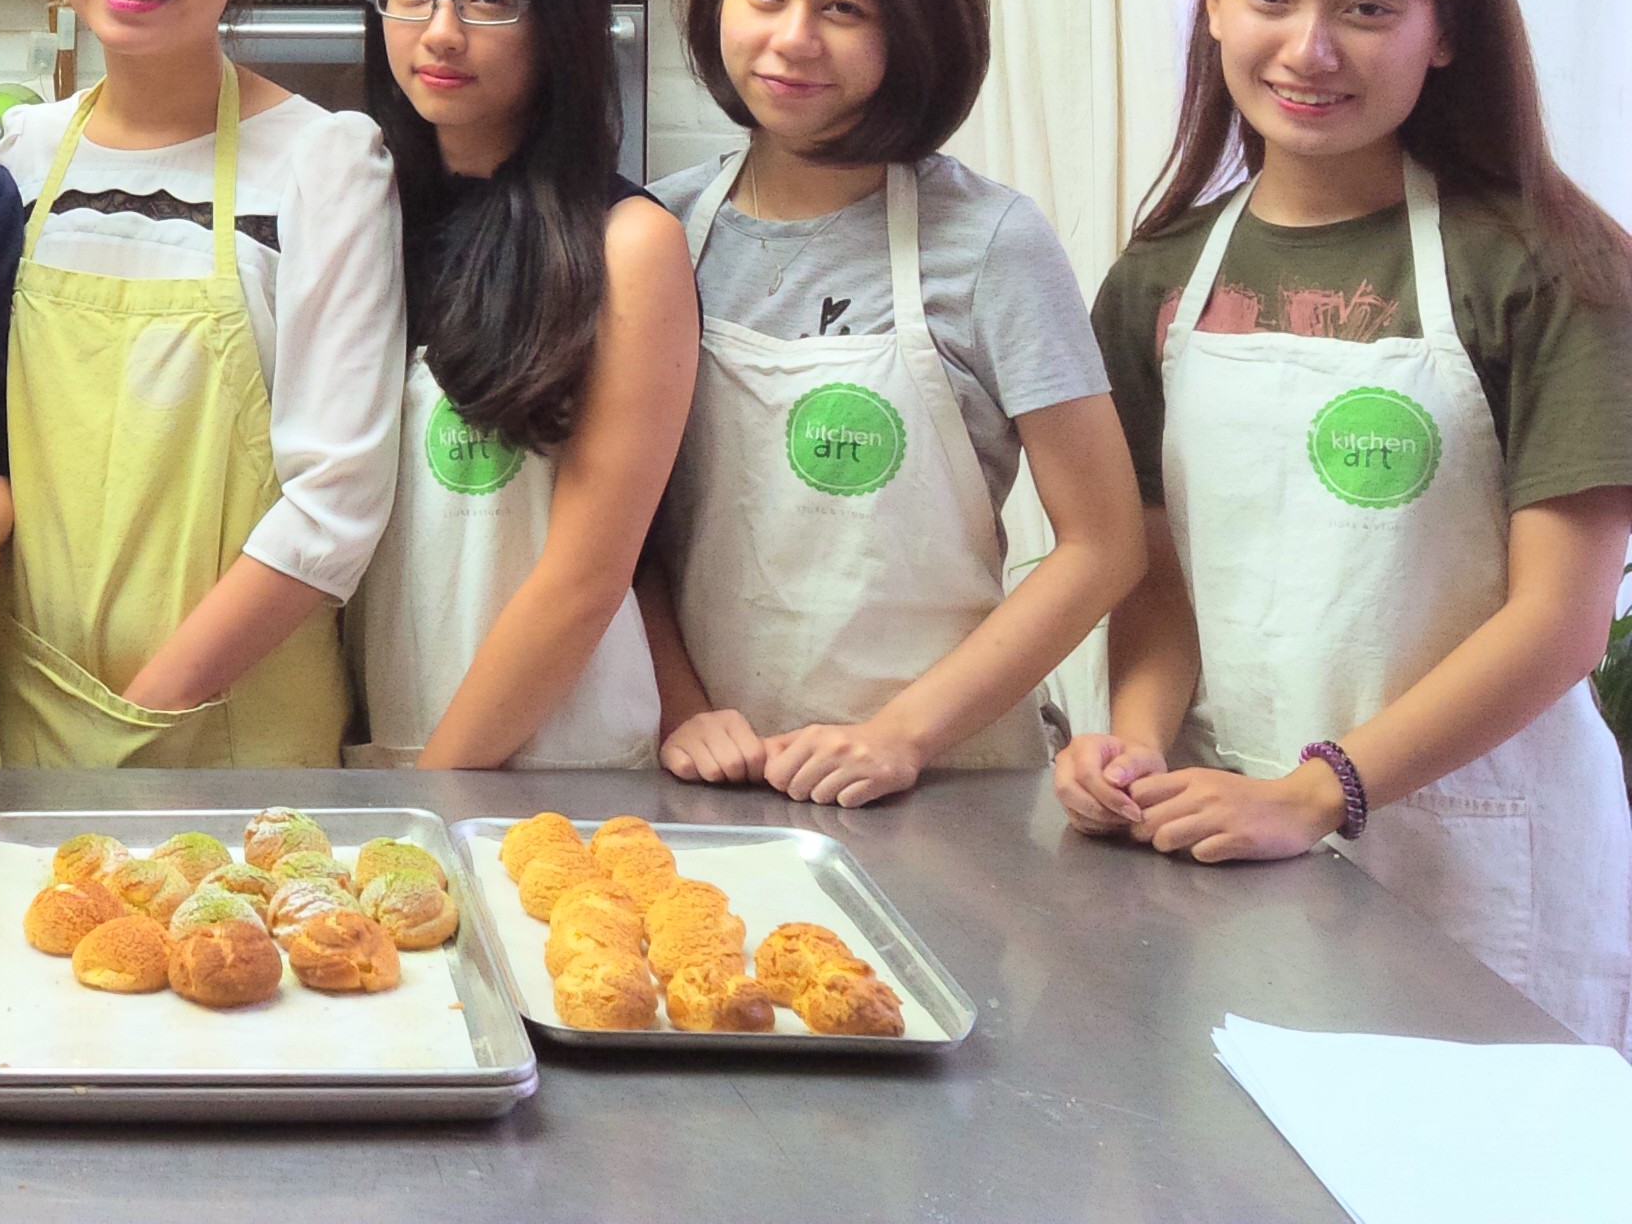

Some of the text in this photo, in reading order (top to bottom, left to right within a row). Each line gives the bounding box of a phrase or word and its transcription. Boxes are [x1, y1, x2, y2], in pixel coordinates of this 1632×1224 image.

[805, 421, 883, 447] kitchen
[1331, 430, 1417, 454] kitchen
[449, 439, 490, 461] art
[814, 440, 862, 463] art
[1343, 445, 1392, 470] art
